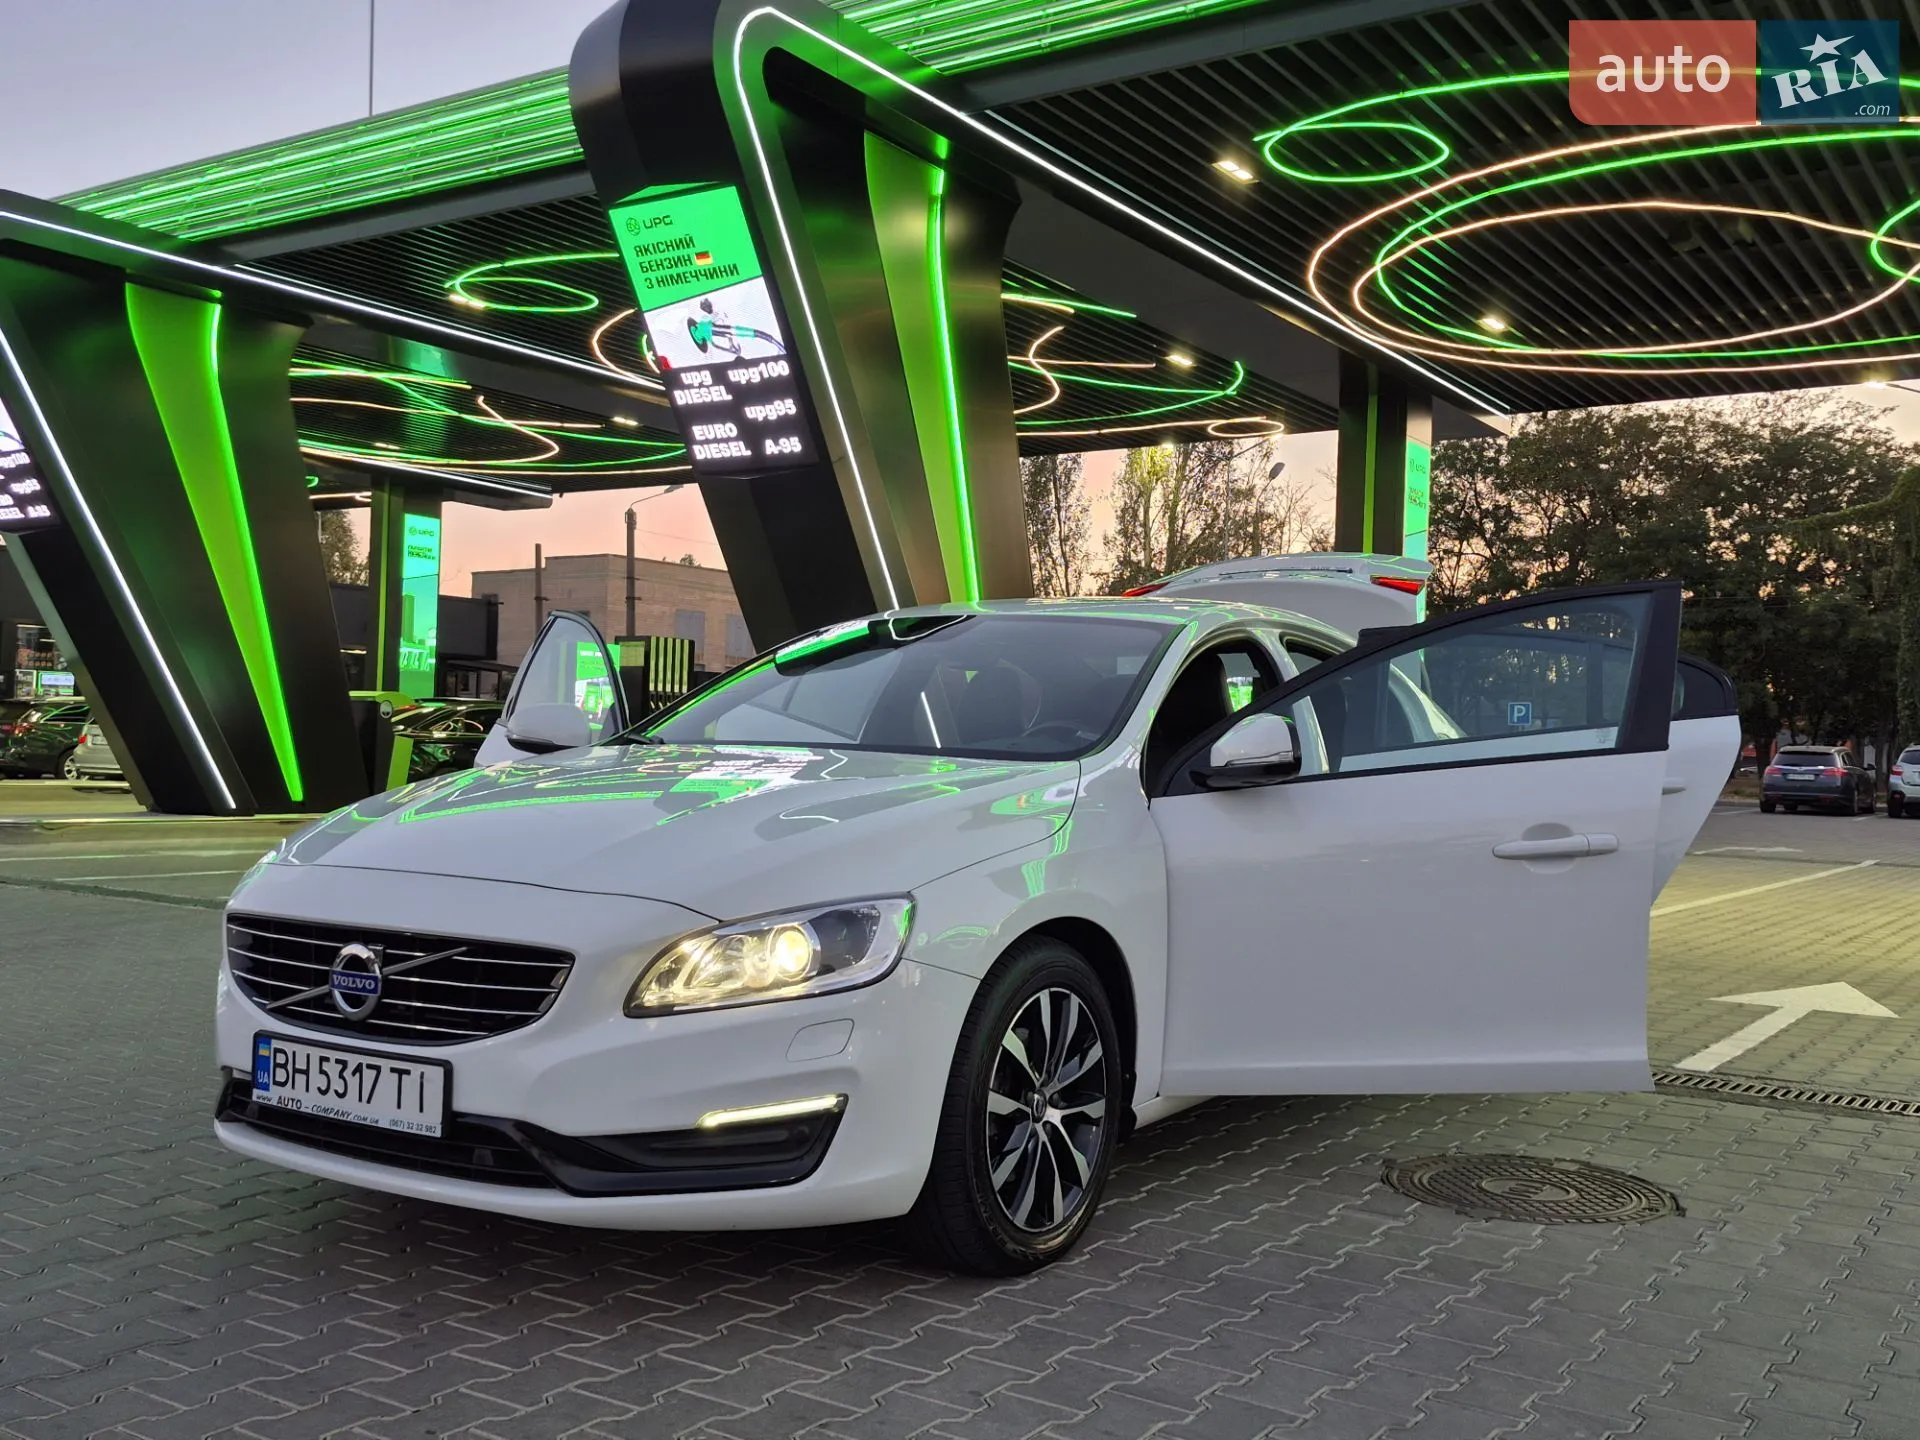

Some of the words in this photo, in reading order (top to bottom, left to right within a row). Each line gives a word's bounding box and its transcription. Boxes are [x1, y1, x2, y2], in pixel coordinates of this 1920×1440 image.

[643, 215, 673, 229] UPG
[634, 234, 695, 257] ЯКІСНИЙ
[640, 254, 693, 273] БЕНЗИН
[656, 263, 740, 288] НІМЕЧЧИНИ
[680, 370, 712, 386] upg
[728, 360, 789, 384] upg100
[673, 385, 733, 405] DIESEL
[744, 398, 796, 421] upg95
[692, 422, 738, 440] EURO
[692, 441, 752, 460] DIESEL
[765, 436, 802, 455] A-95
[1514, 705, 1526, 722] P
[332, 974, 375, 989] VOLVO
[257, 1071, 269, 1084] UA
[272, 1047, 311, 1093] BH
[317, 1055, 382, 1105] 5317
[276, 1095, 302, 1110] AUTO
